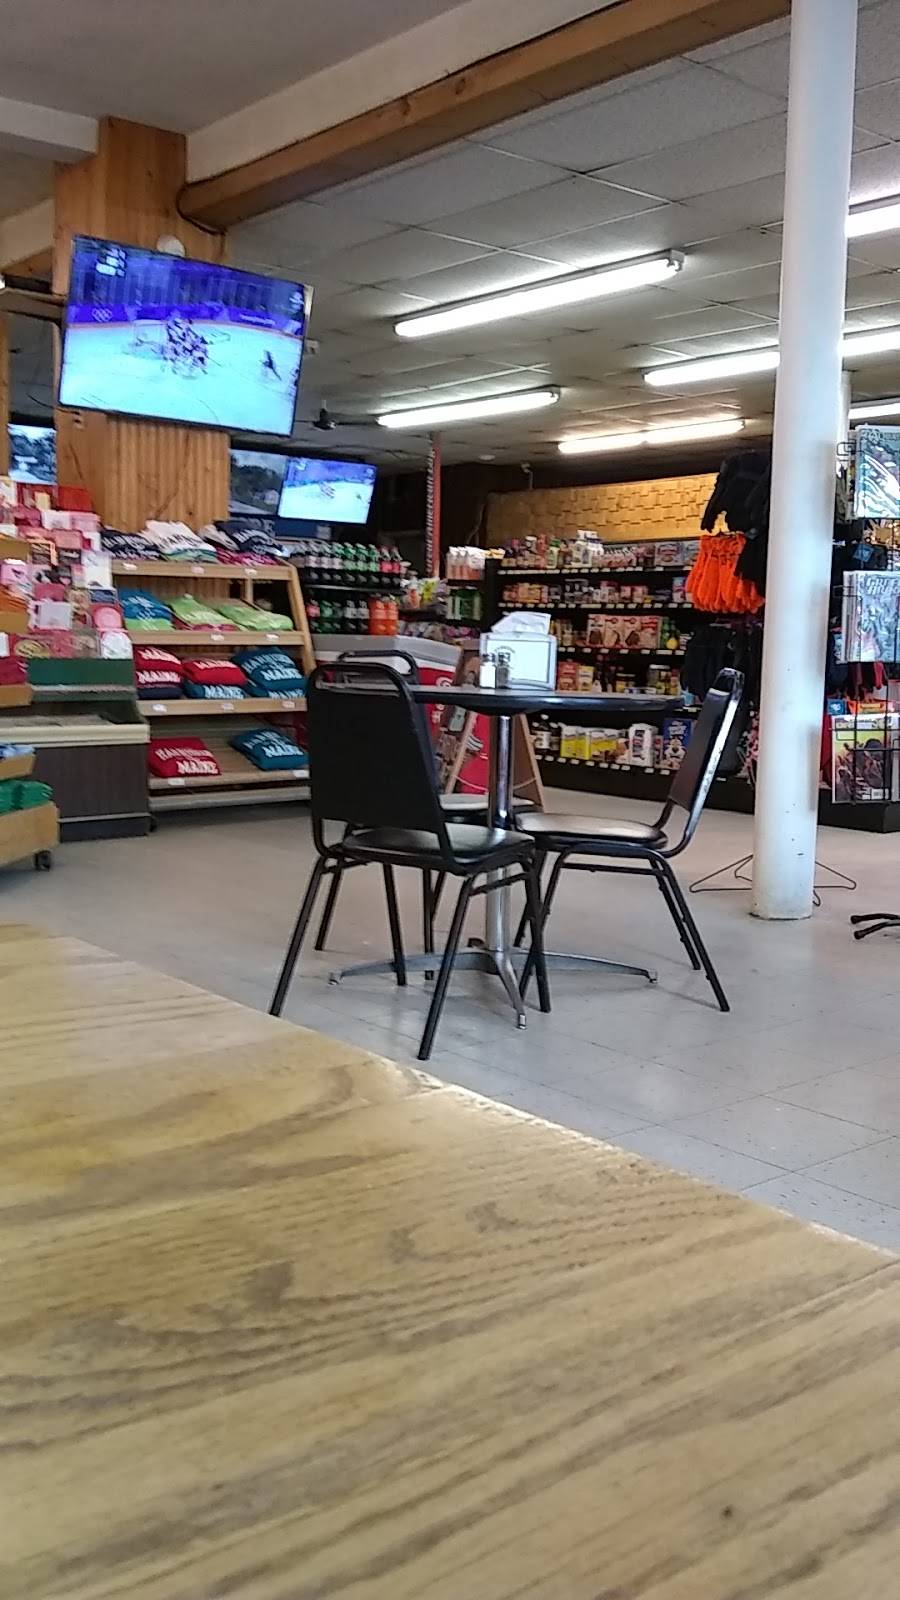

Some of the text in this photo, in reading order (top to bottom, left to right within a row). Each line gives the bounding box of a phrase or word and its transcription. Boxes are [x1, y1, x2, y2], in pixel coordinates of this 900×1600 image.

[136, 670, 181, 684] MAINE
[261, 668, 303, 681] MAINE
[203, 685, 244, 699] MAINE
[176, 759, 219, 774] MAINE
